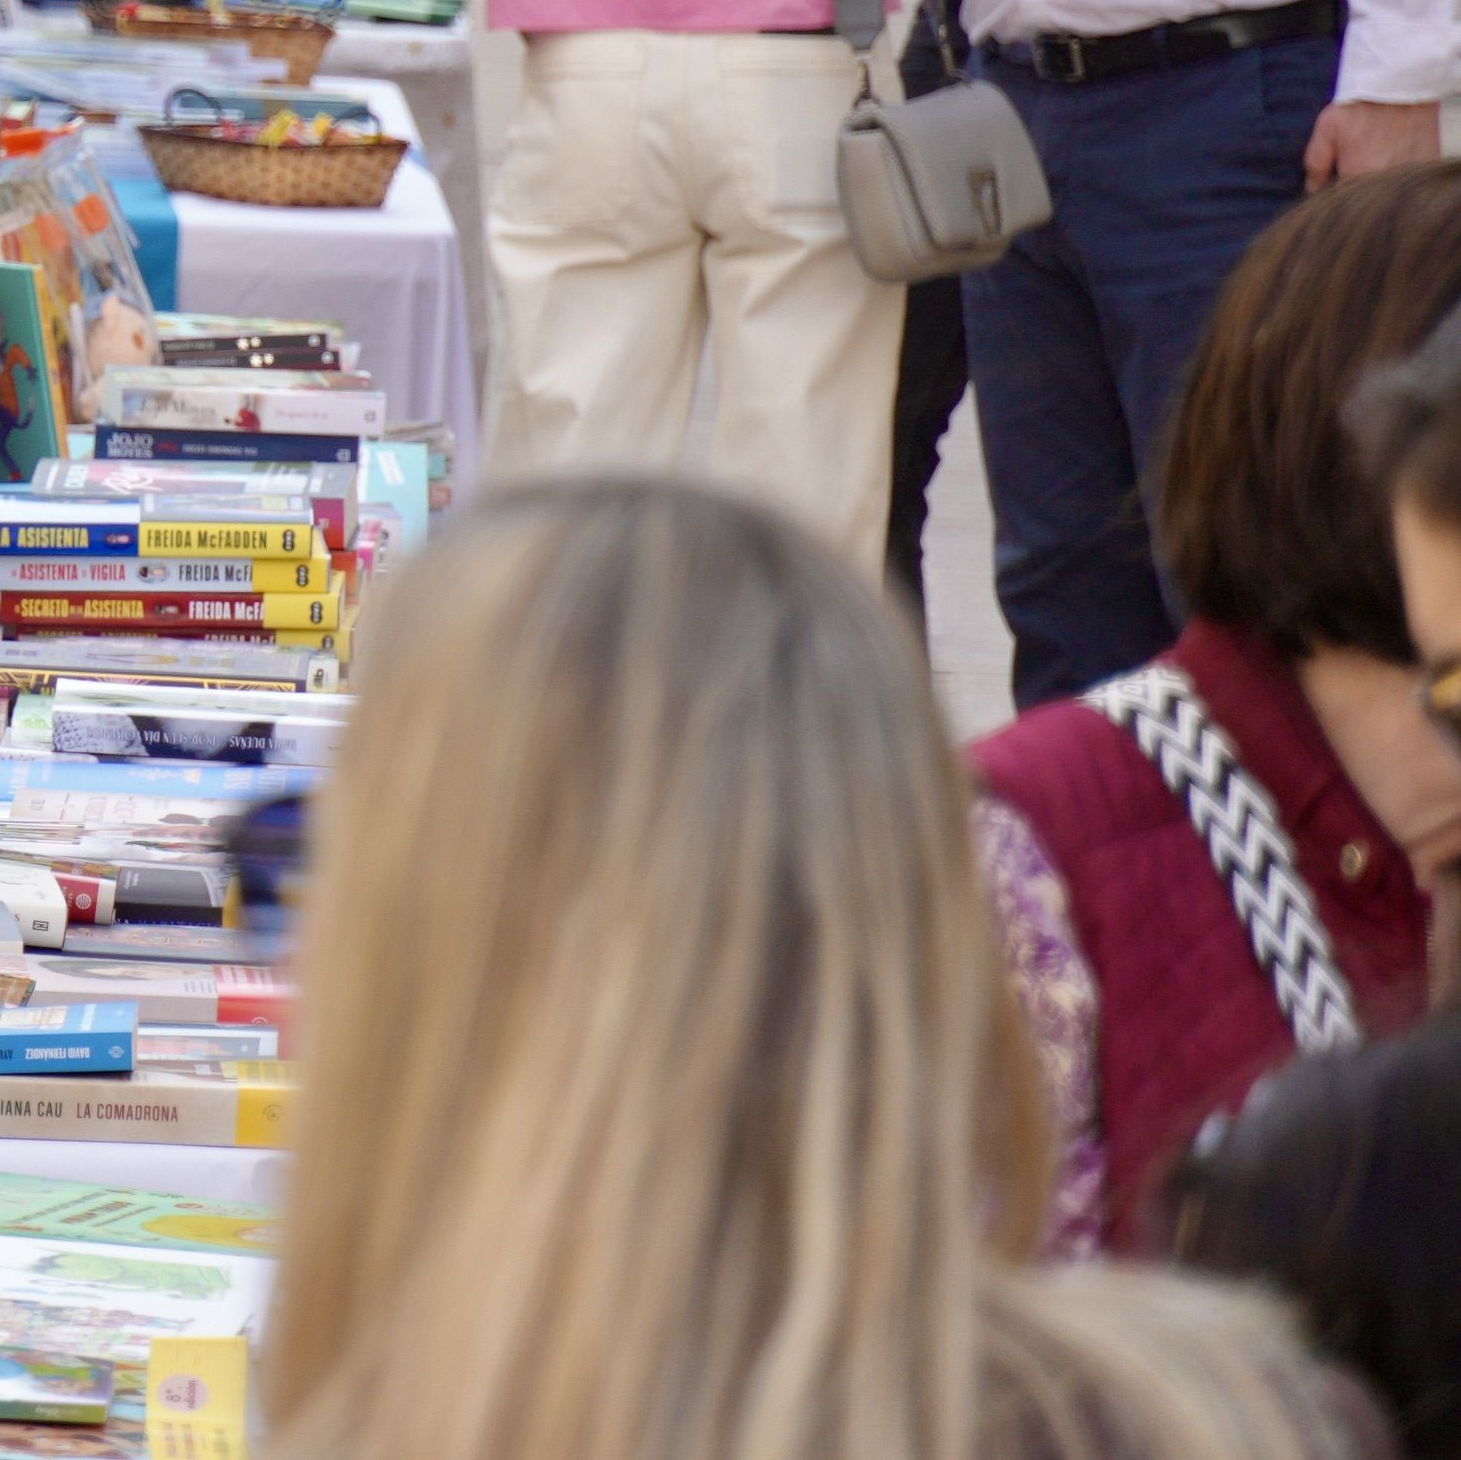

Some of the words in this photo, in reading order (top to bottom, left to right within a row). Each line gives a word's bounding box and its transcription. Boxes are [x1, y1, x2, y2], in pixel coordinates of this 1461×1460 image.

[17, 526, 89, 549] ASISTENTA
[147, 528, 192, 549] FREIDA
[198, 530, 268, 550] McFADDEN
[20, 563, 78, 581] ASISTENTA
[90, 563, 126, 581] VIGILA
[179, 563, 219, 582] FREIDA
[20, 598, 70, 618] SECRETO
[84, 599, 145, 619] ASISTENTA
[188, 600, 232, 621] FREIDA
[144, 729, 161, 744] DÍA
[229, 734, 266, 750] DUEÑAS
[25, 1047, 67, 1061] FERNÁNDEZ
[67, 1047, 90, 1059] DAVID
[37, 1100, 63, 1119] CAU
[77, 1103, 91, 1119] LA
[96, 1103, 178, 1123] COMADRONA
